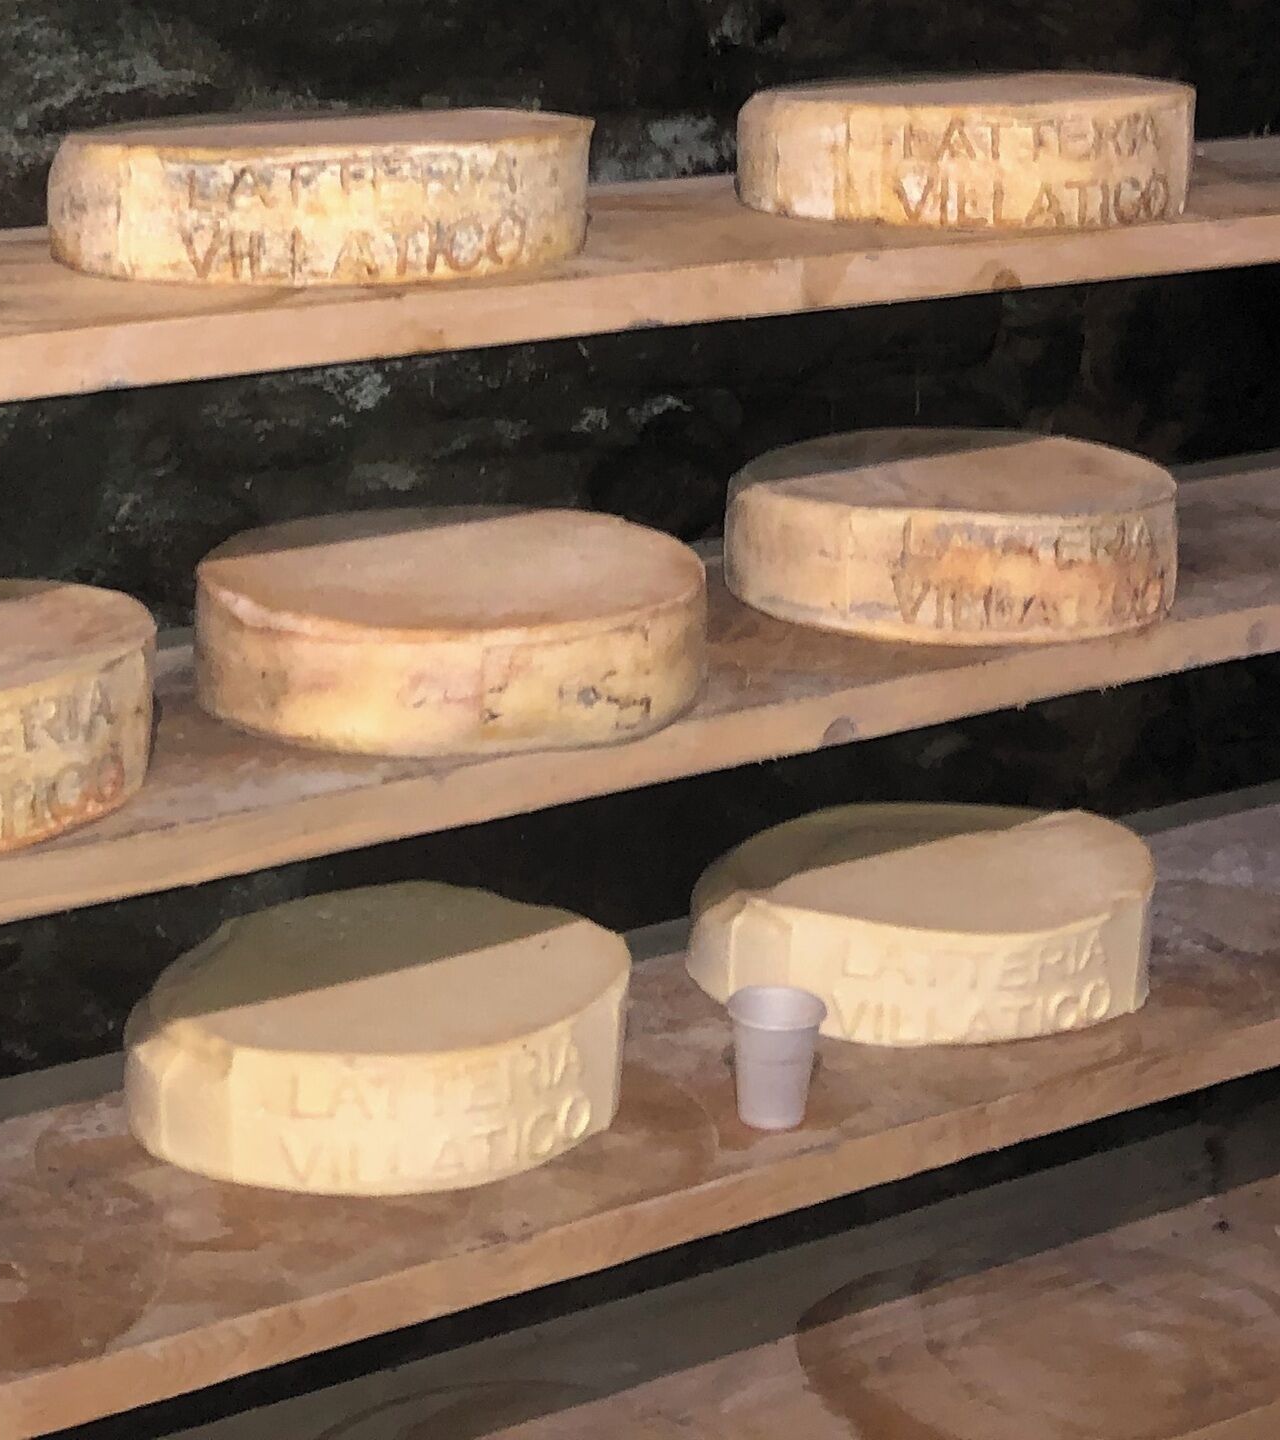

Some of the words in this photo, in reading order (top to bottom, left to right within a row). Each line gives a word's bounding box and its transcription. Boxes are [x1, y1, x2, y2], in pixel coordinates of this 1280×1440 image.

[903, 111, 1159, 161] LATTERIA
[893, 167, 1171, 227] VILLATICO
[179, 212, 526, 280] VILLATICO
